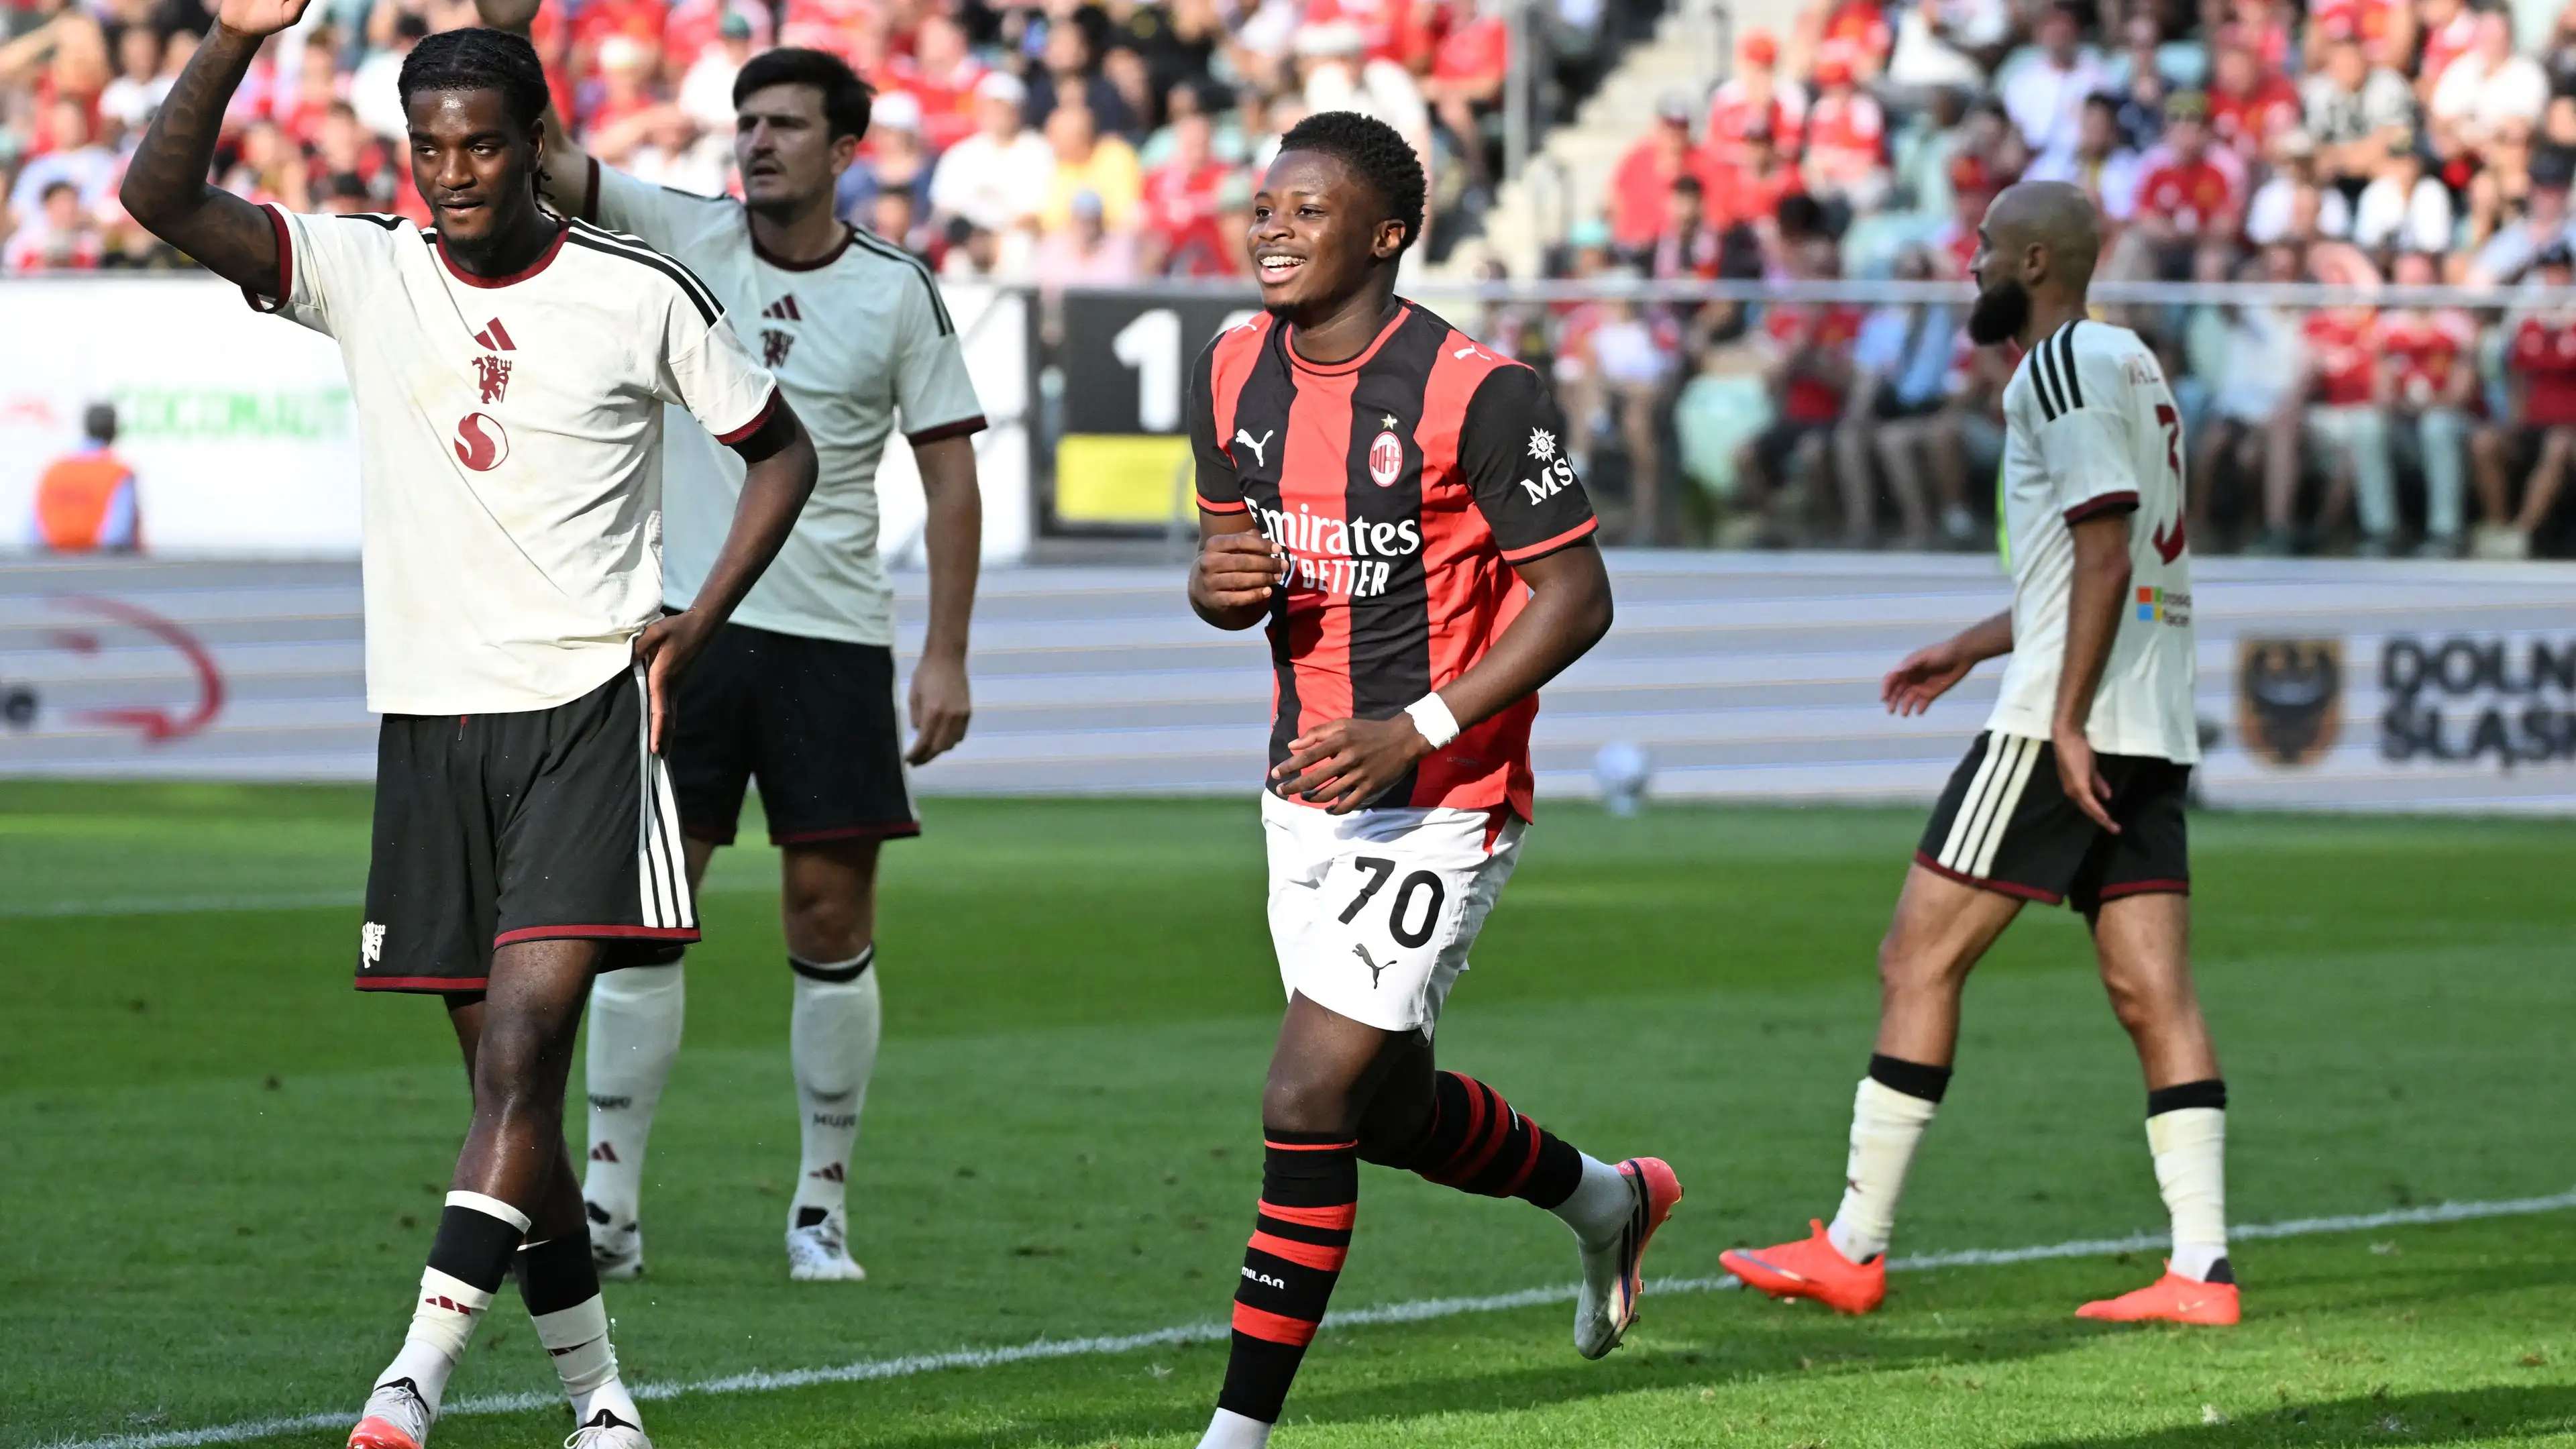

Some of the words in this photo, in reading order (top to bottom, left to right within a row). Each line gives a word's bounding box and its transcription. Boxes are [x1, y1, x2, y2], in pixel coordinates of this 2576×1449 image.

[1519, 453, 1577, 506] MS
[1244, 496, 1420, 556] Emirates
[1300, 559, 1390, 597] BETTER
[1338, 855, 1445, 949] 70
